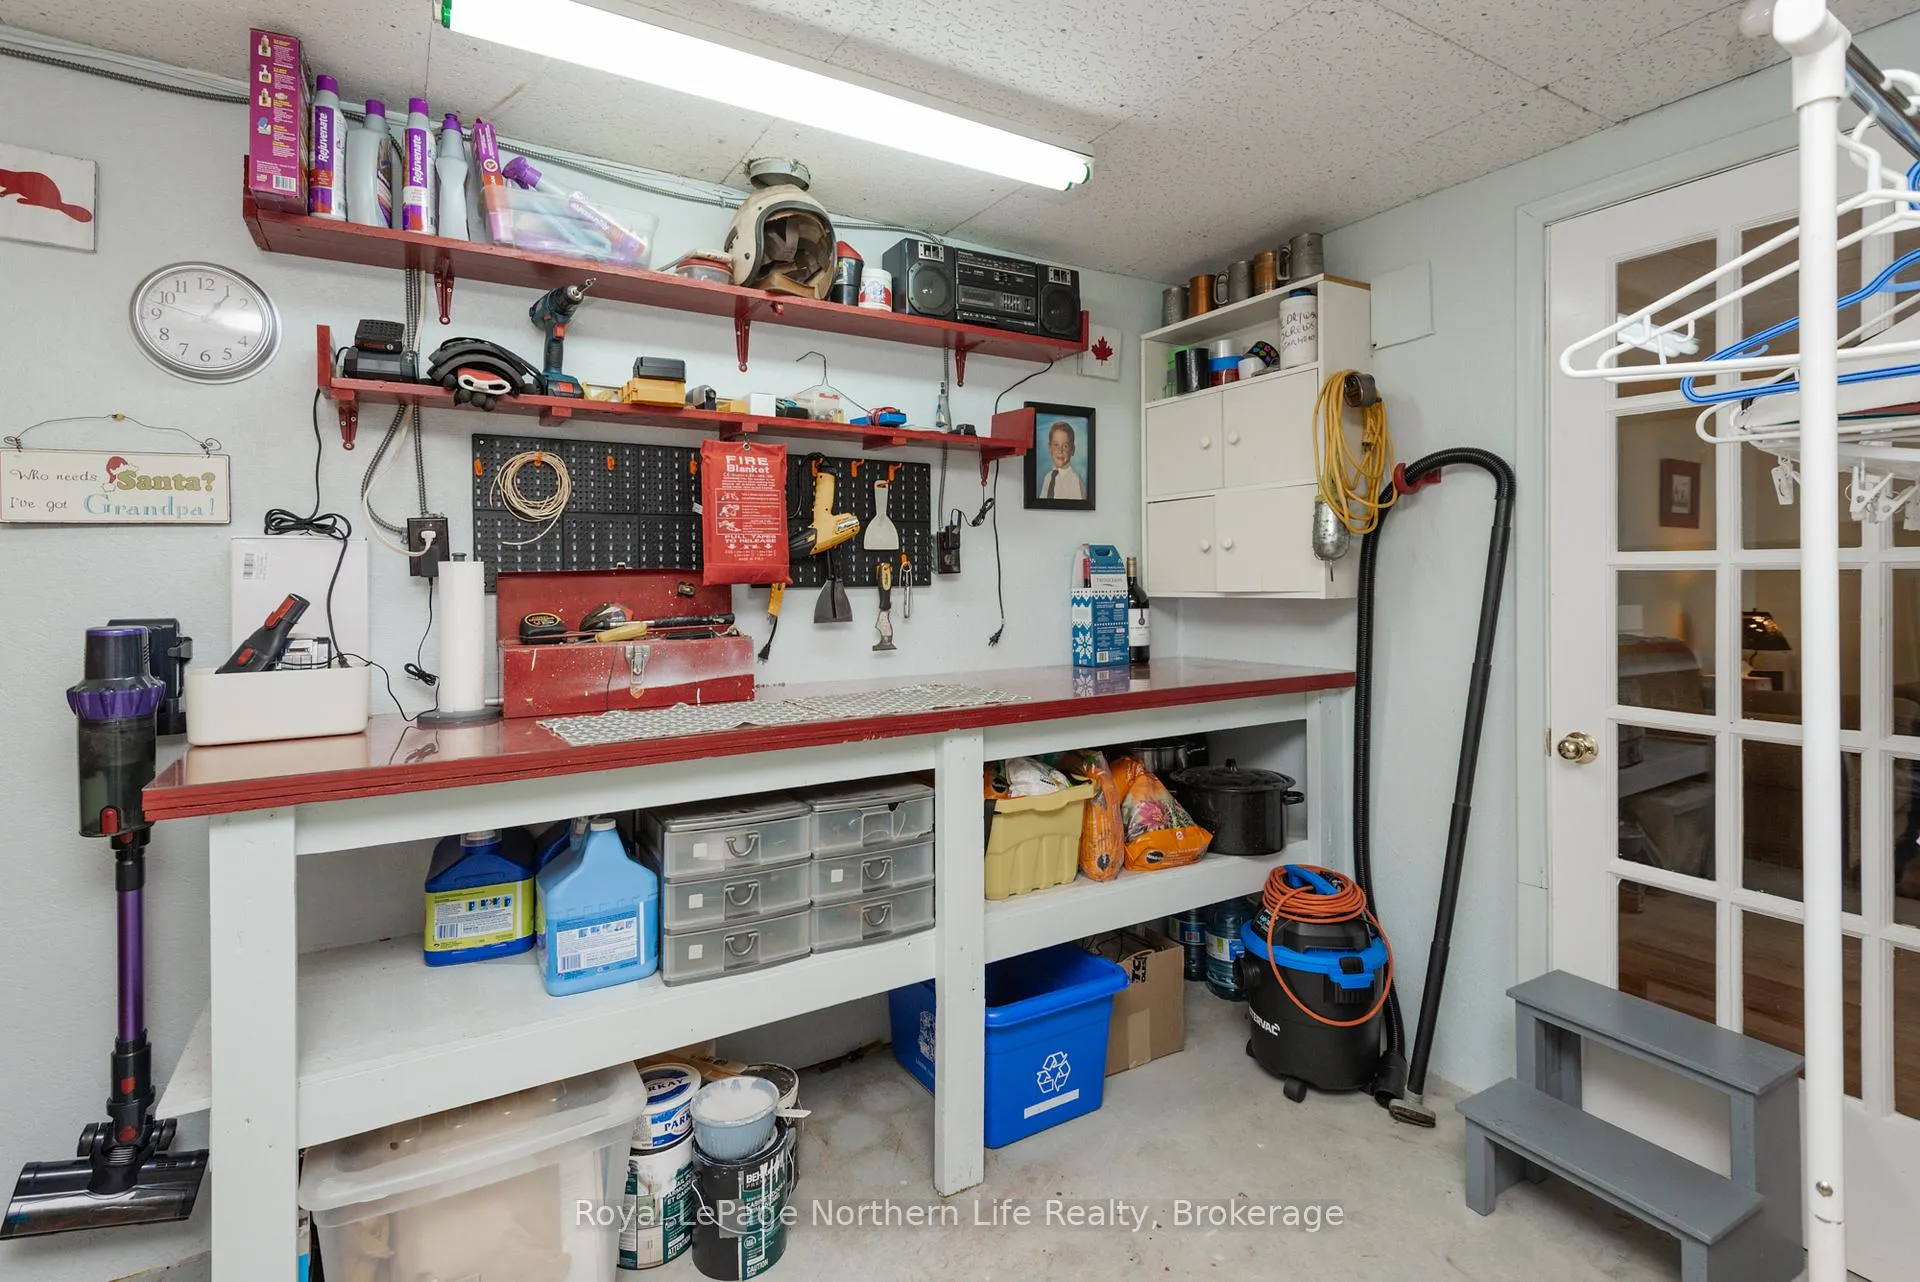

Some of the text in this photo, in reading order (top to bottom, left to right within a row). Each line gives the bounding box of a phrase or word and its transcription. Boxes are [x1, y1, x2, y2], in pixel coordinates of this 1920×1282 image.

[318, 112, 330, 163] Rejuvenate
[413, 134, 423, 184] Rejuvenate
[175, 279, 187, 294] 11
[197, 277, 216, 291] 12
[160, 291, 176, 304] 10
[225, 285, 230, 298] 1
[239, 298, 249, 310] 2
[151, 307, 163, 320] 9
[159, 327, 170, 341] 8
[237, 335, 249, 348] 4
[178, 342, 189, 356] 7
[200, 350, 211, 362] 6
[222, 347, 233, 361] 5
[725, 455, 769, 466] FIRE
[726, 464, 769, 474] Blanket
[9, 468, 216, 492] Who needs Santa?
[9, 496, 36, 509] I've
[46, 499, 68, 512] got
[648, 1079, 684, 1092] RKAY
[664, 1113, 692, 1131] PARK
[746, 1258, 769, 1275] CAUTION
